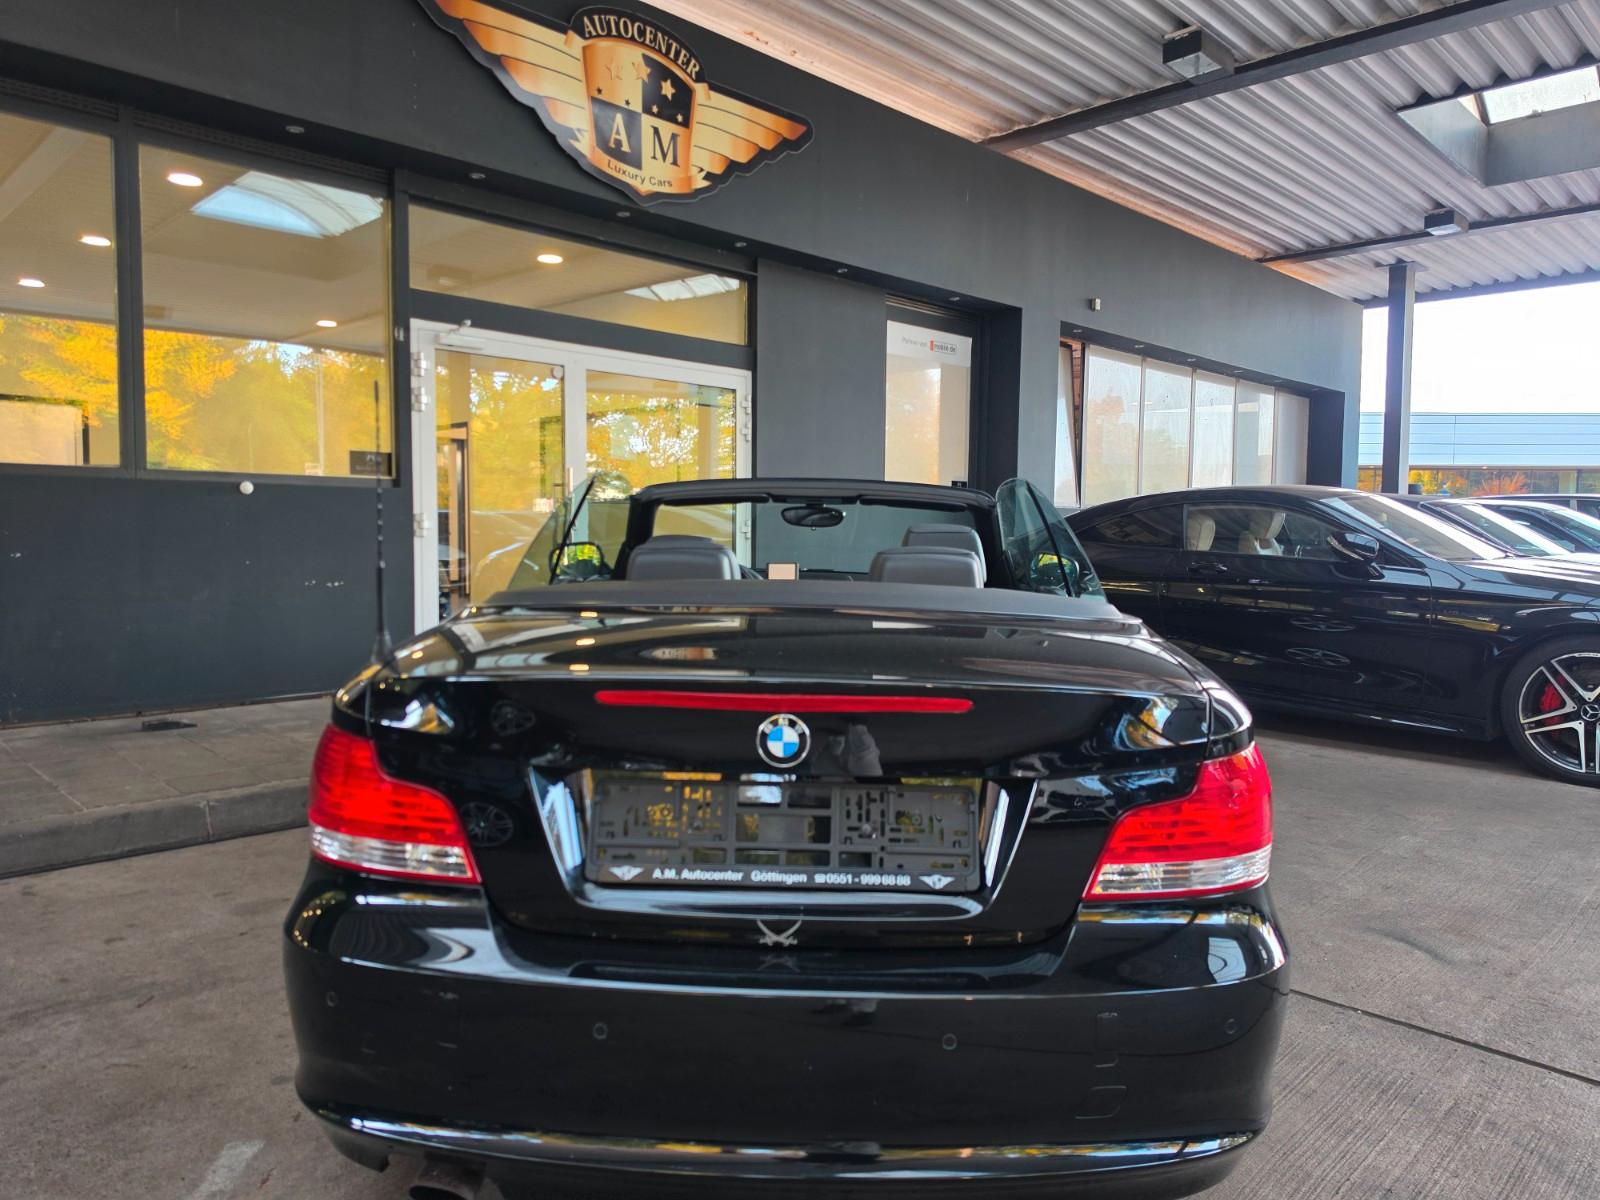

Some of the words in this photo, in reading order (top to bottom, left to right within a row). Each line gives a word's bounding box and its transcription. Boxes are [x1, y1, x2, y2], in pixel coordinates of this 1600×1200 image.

[583, 15, 700, 79] AUTOCENTER
[608, 112, 631, 153] A
[650, 125, 680, 168] M
[607, 159, 646, 185] Luxury
[649, 176, 673, 188] Cars
[652, 867, 680, 880] A.M.
[681, 867, 744, 882] Autocenter
[751, 869, 807, 885] Göttingen
